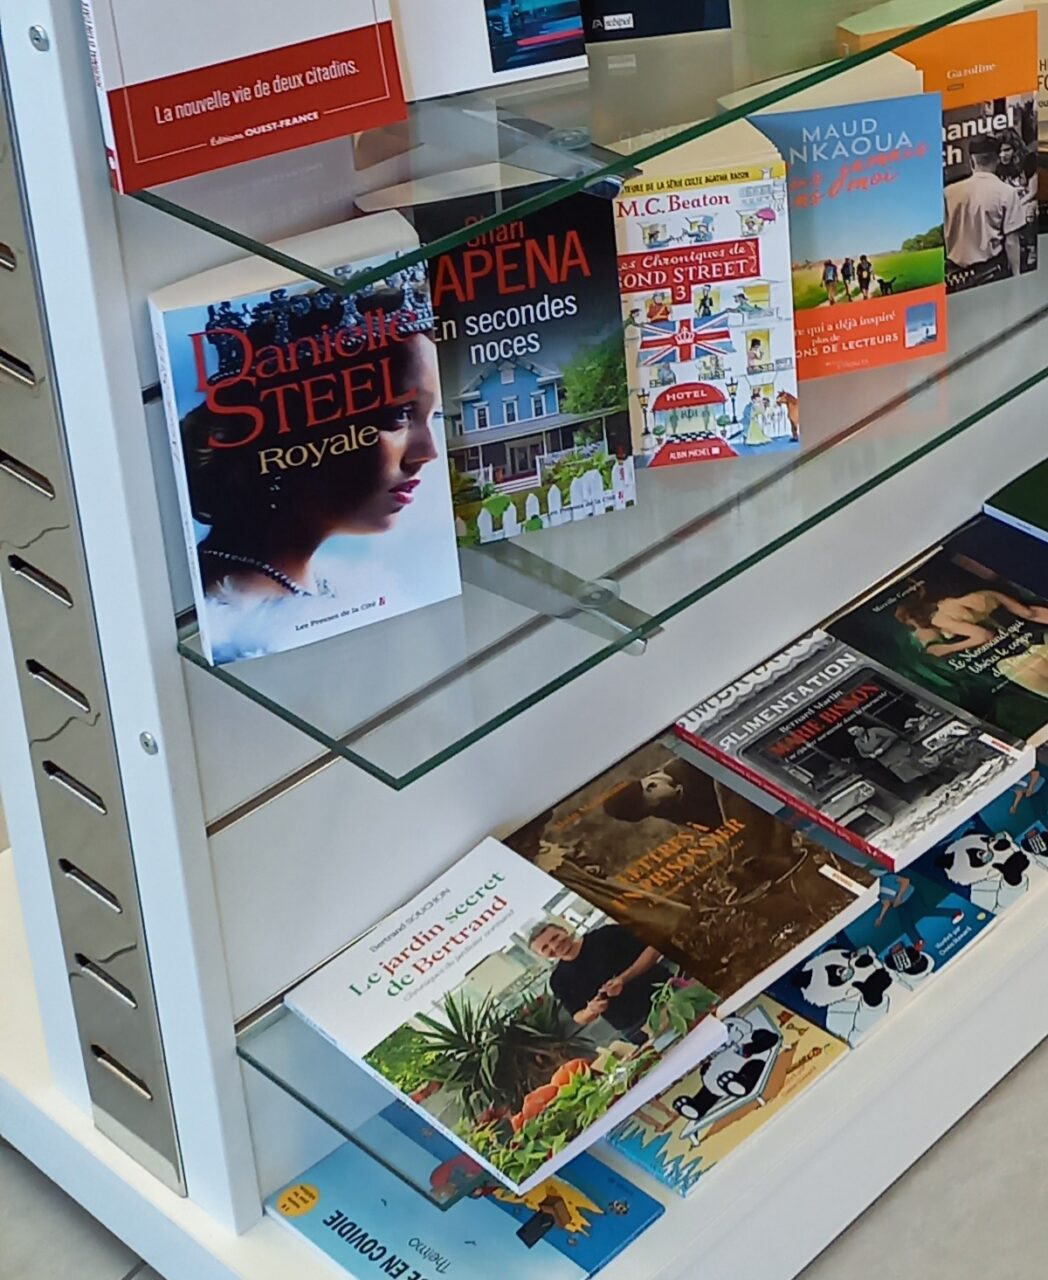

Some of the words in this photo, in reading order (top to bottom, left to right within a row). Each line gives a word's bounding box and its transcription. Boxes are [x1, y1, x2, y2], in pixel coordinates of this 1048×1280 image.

[946, 62, 996, 79] Gazoline
[155, 105, 172, 124] La
[175, 87, 231, 120] nouvelle
[231, 83, 252, 104] vie
[254, 79, 270, 98] de
[274, 72, 305, 95] deux
[306, 58, 359, 85] citadins.
[802, 118, 878, 142] MAUD
[789, 131, 913, 163] NKAOUA
[616, 197, 665, 218] M.C.
[668, 194, 730, 212] Beaton
[643, 247, 725, 267] Chroniques
[729, 243, 746, 255] de
[676, 286, 686, 300] 3
[188, 308, 418, 394] Danielle
[470, 331, 540, 365] noces
[206, 357, 419, 449] STEEL
[665, 389, 708, 402] HOTEL
[258, 423, 380, 475] Royale
[669, 448, 687, 459] ALBIN
[688, 446, 711, 457] MICHEL
[348, 972, 382, 996] Le
[379, 923, 445, 976] jardin
[445, 872, 505, 924] secret
[387, 973, 414, 997] de
[412, 895, 508, 975] Bertrand
[322, 1209, 387, 1261] COVIDIE
[380, 1255, 409, 1279] EN
[408, 1237, 451, 1273] Thelmo
